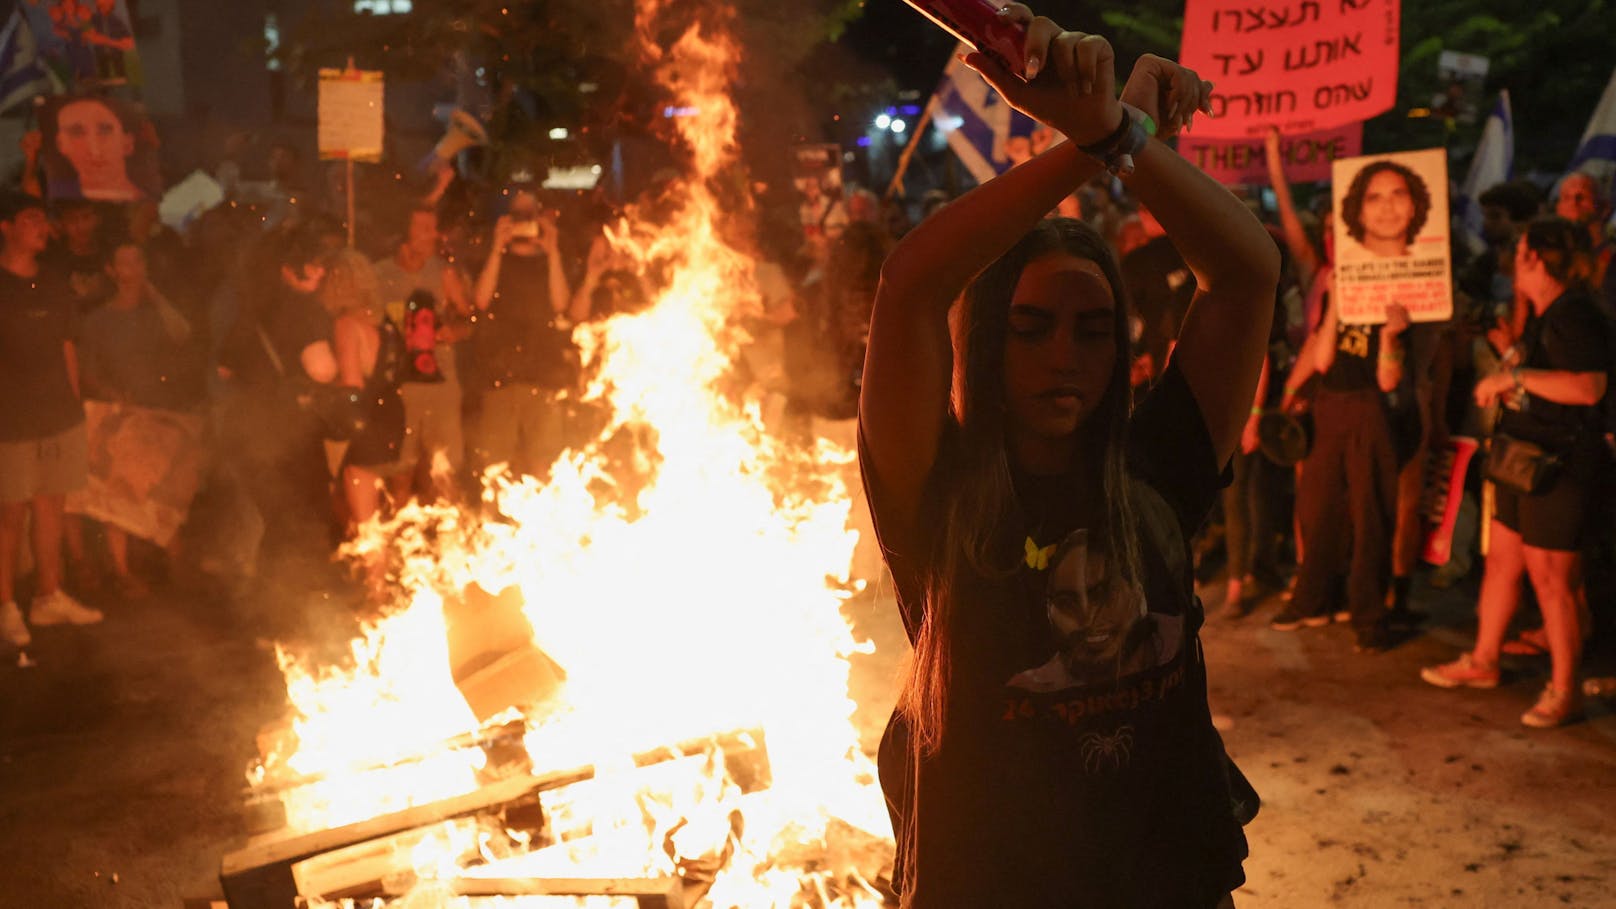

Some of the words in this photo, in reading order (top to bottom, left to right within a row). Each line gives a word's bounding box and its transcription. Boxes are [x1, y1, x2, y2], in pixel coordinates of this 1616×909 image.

[1212, 1, 1320, 32] תעצרו
[1212, 49, 1263, 75] עד
[1284, 33, 1361, 71] אותנו
[1314, 77, 1374, 109] שהם
[1191, 143, 1266, 170] THEM
[1281, 136, 1346, 166] HOME
